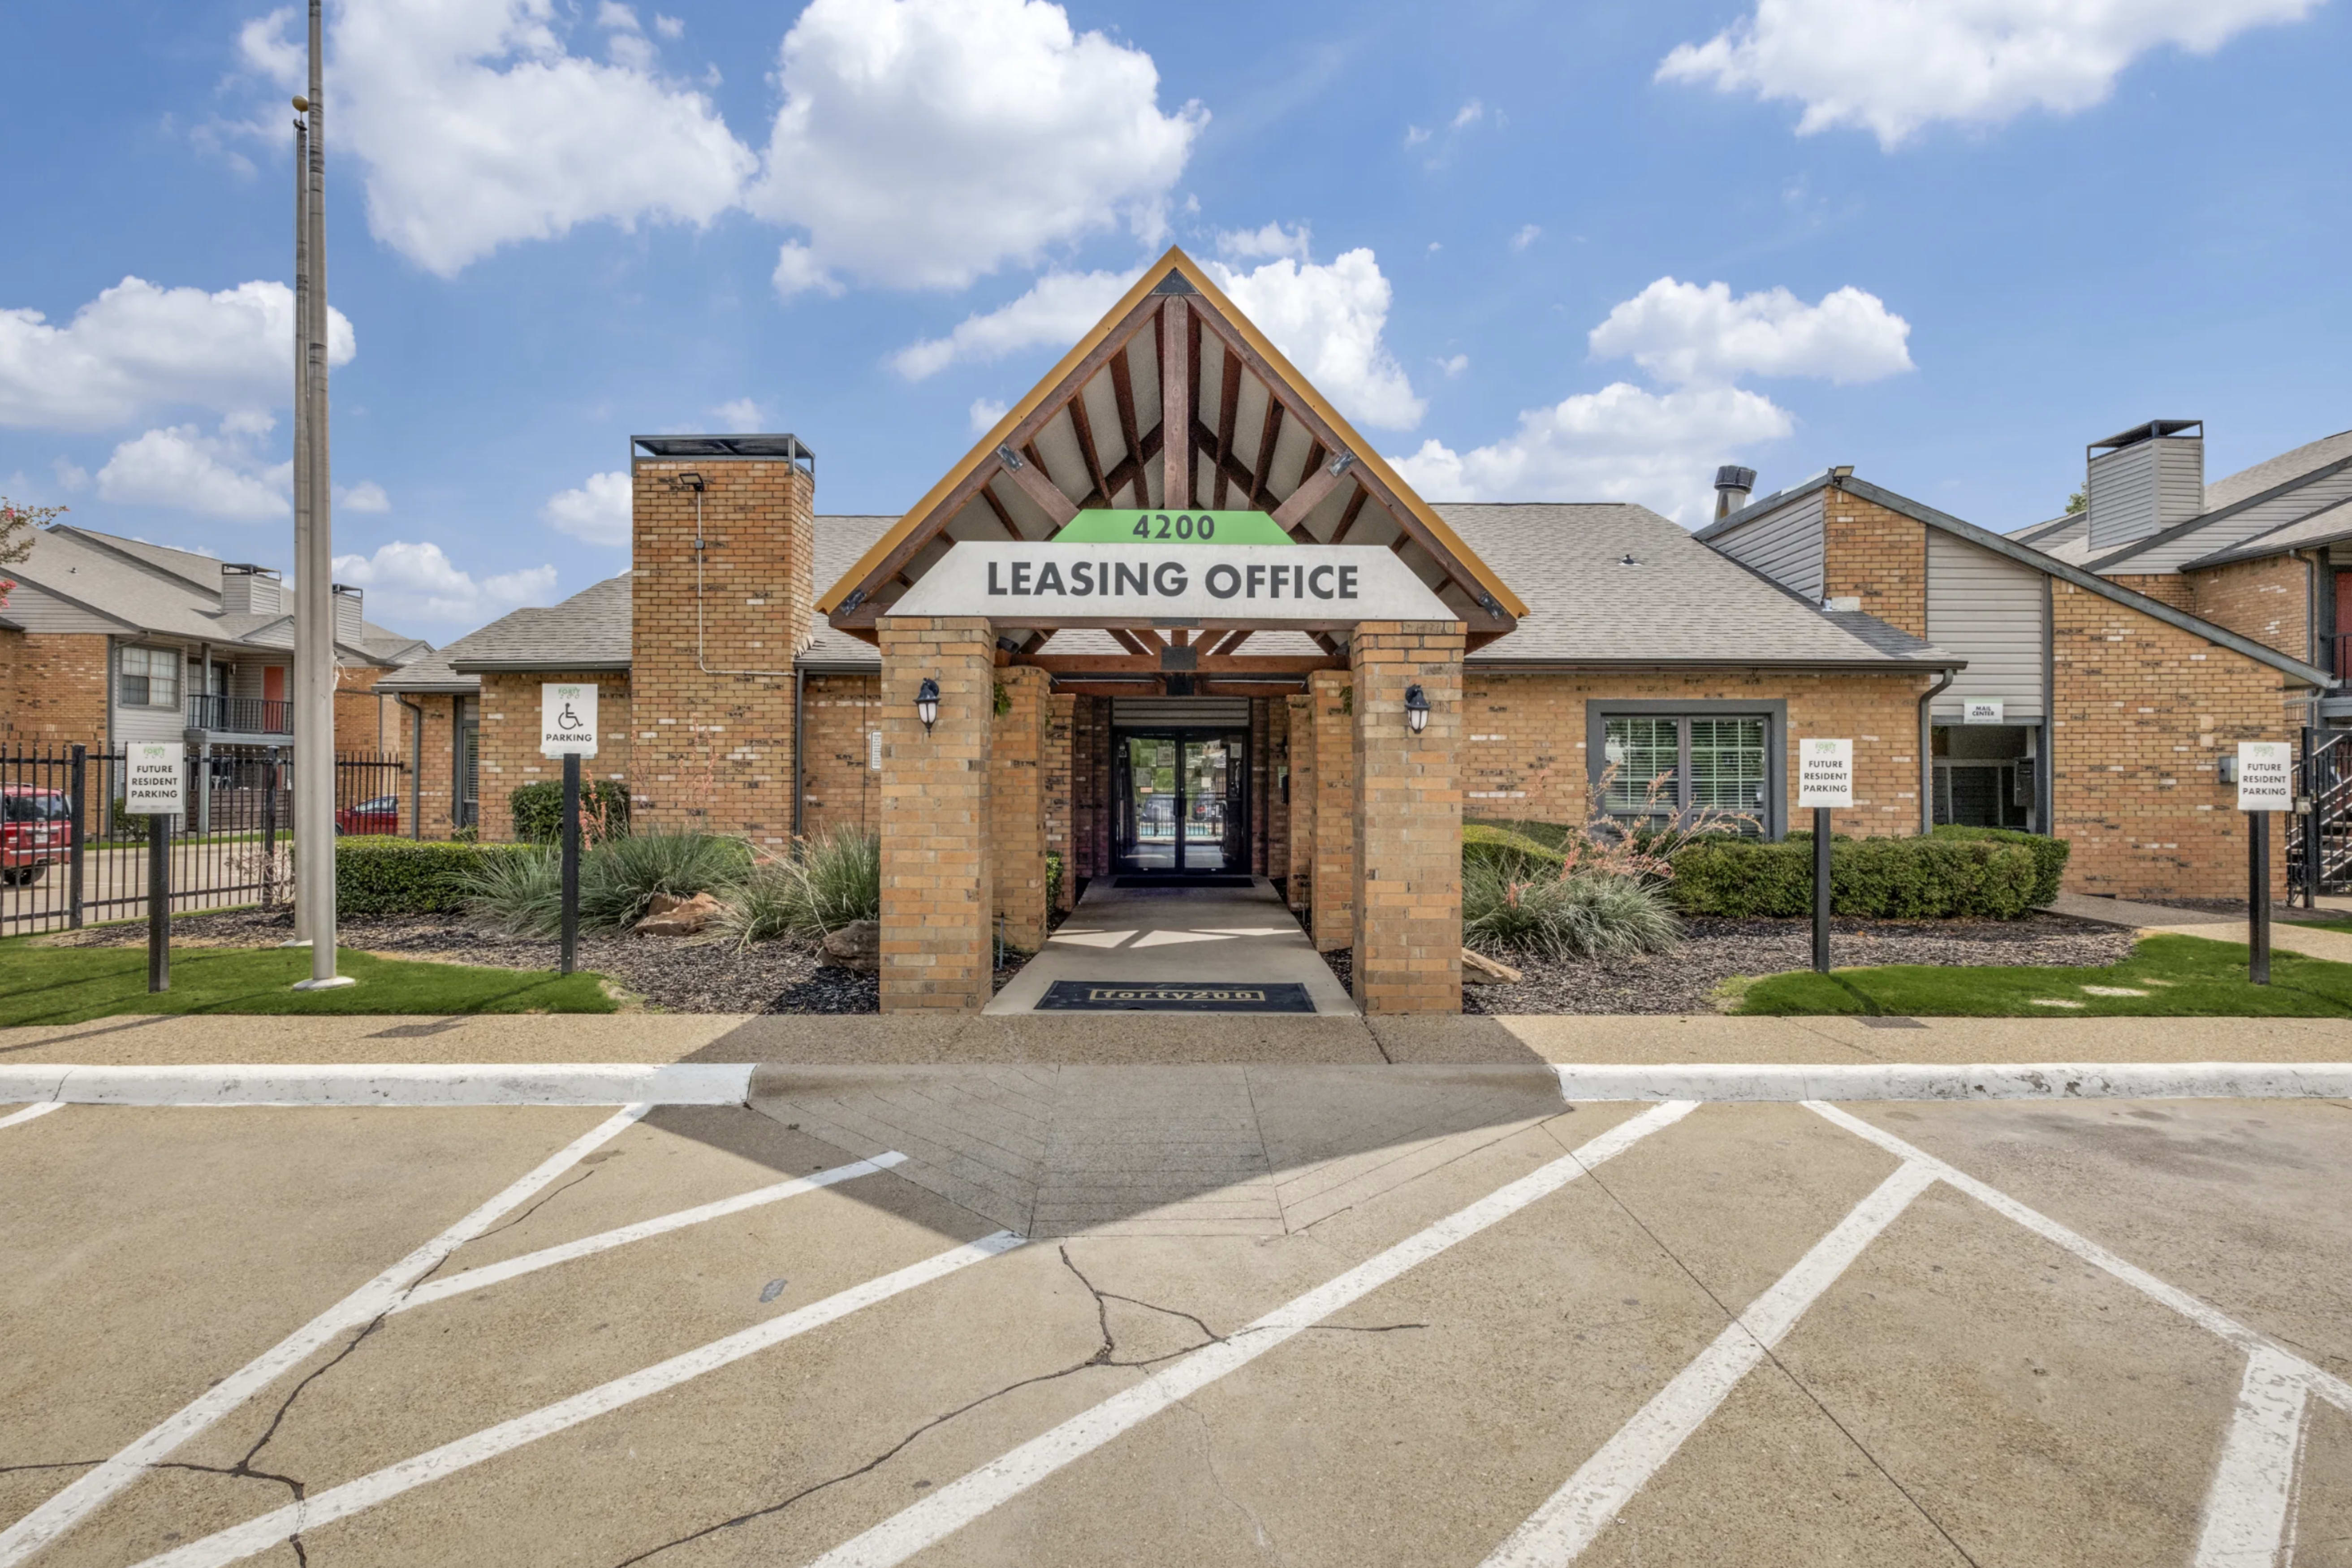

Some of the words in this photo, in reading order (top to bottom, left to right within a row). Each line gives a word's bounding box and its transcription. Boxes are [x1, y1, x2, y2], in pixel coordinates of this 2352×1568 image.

[1132, 514, 1214, 540] 4200
[988, 562, 1188, 596] LEASING
[1205, 564, 1358, 599] OFFICE
